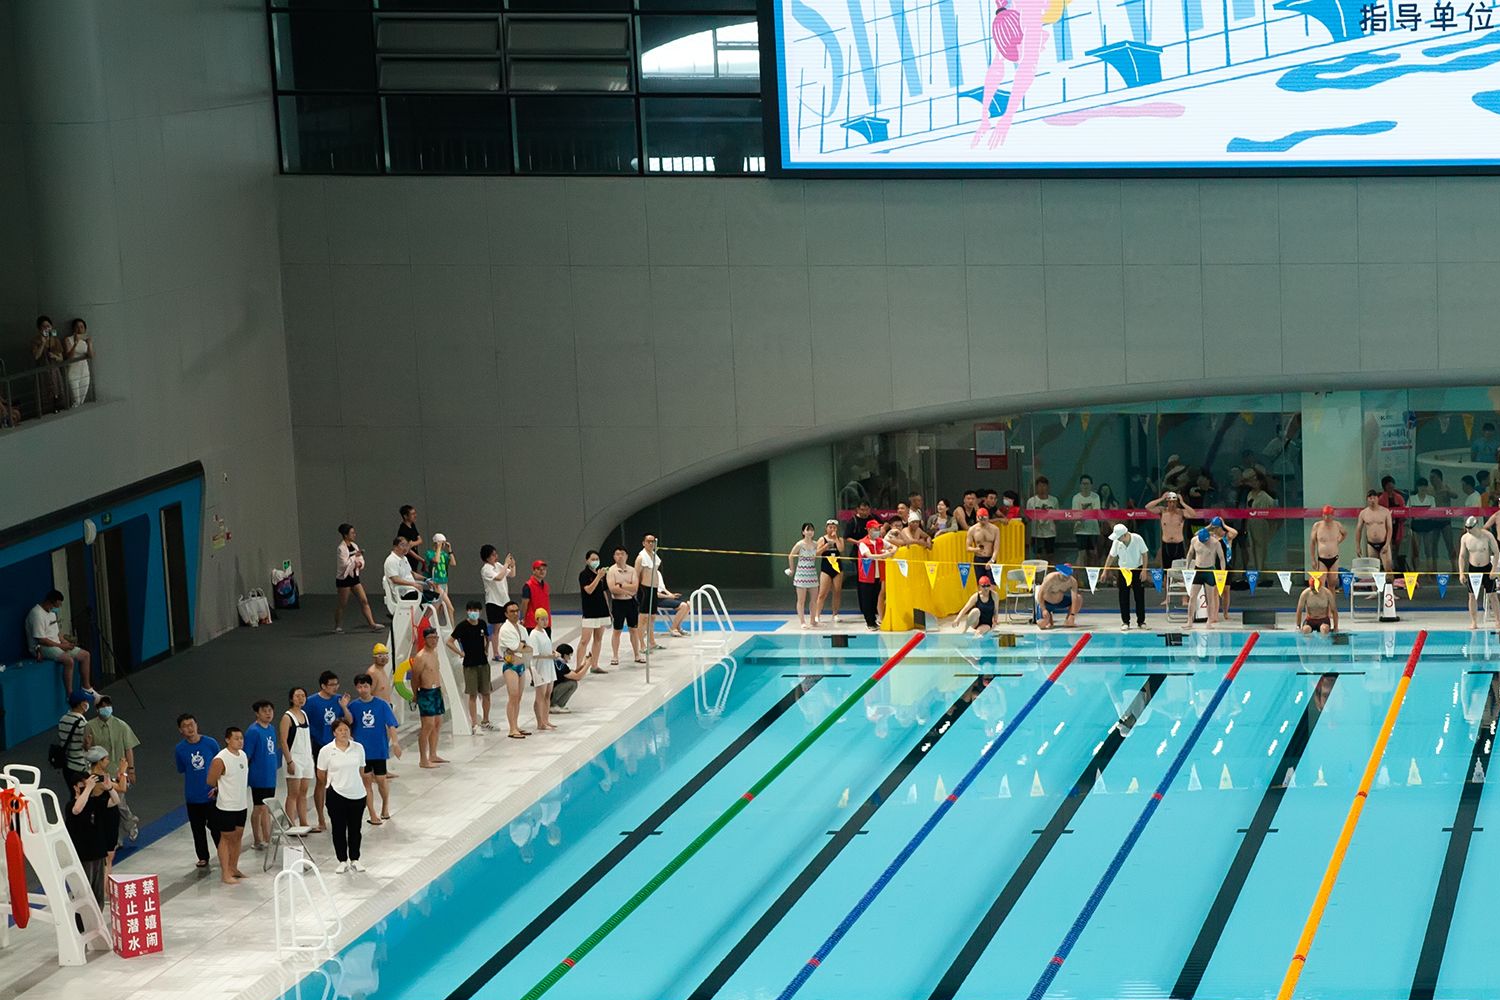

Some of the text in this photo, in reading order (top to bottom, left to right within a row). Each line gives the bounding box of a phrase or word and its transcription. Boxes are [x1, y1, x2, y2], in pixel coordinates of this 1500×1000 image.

[1199, 594, 1208, 608] 2
[1385, 593, 1394, 608] 3
[124, 882, 141, 952] 禁止潜水
[142, 878, 158, 948] 禁止嬉闹
